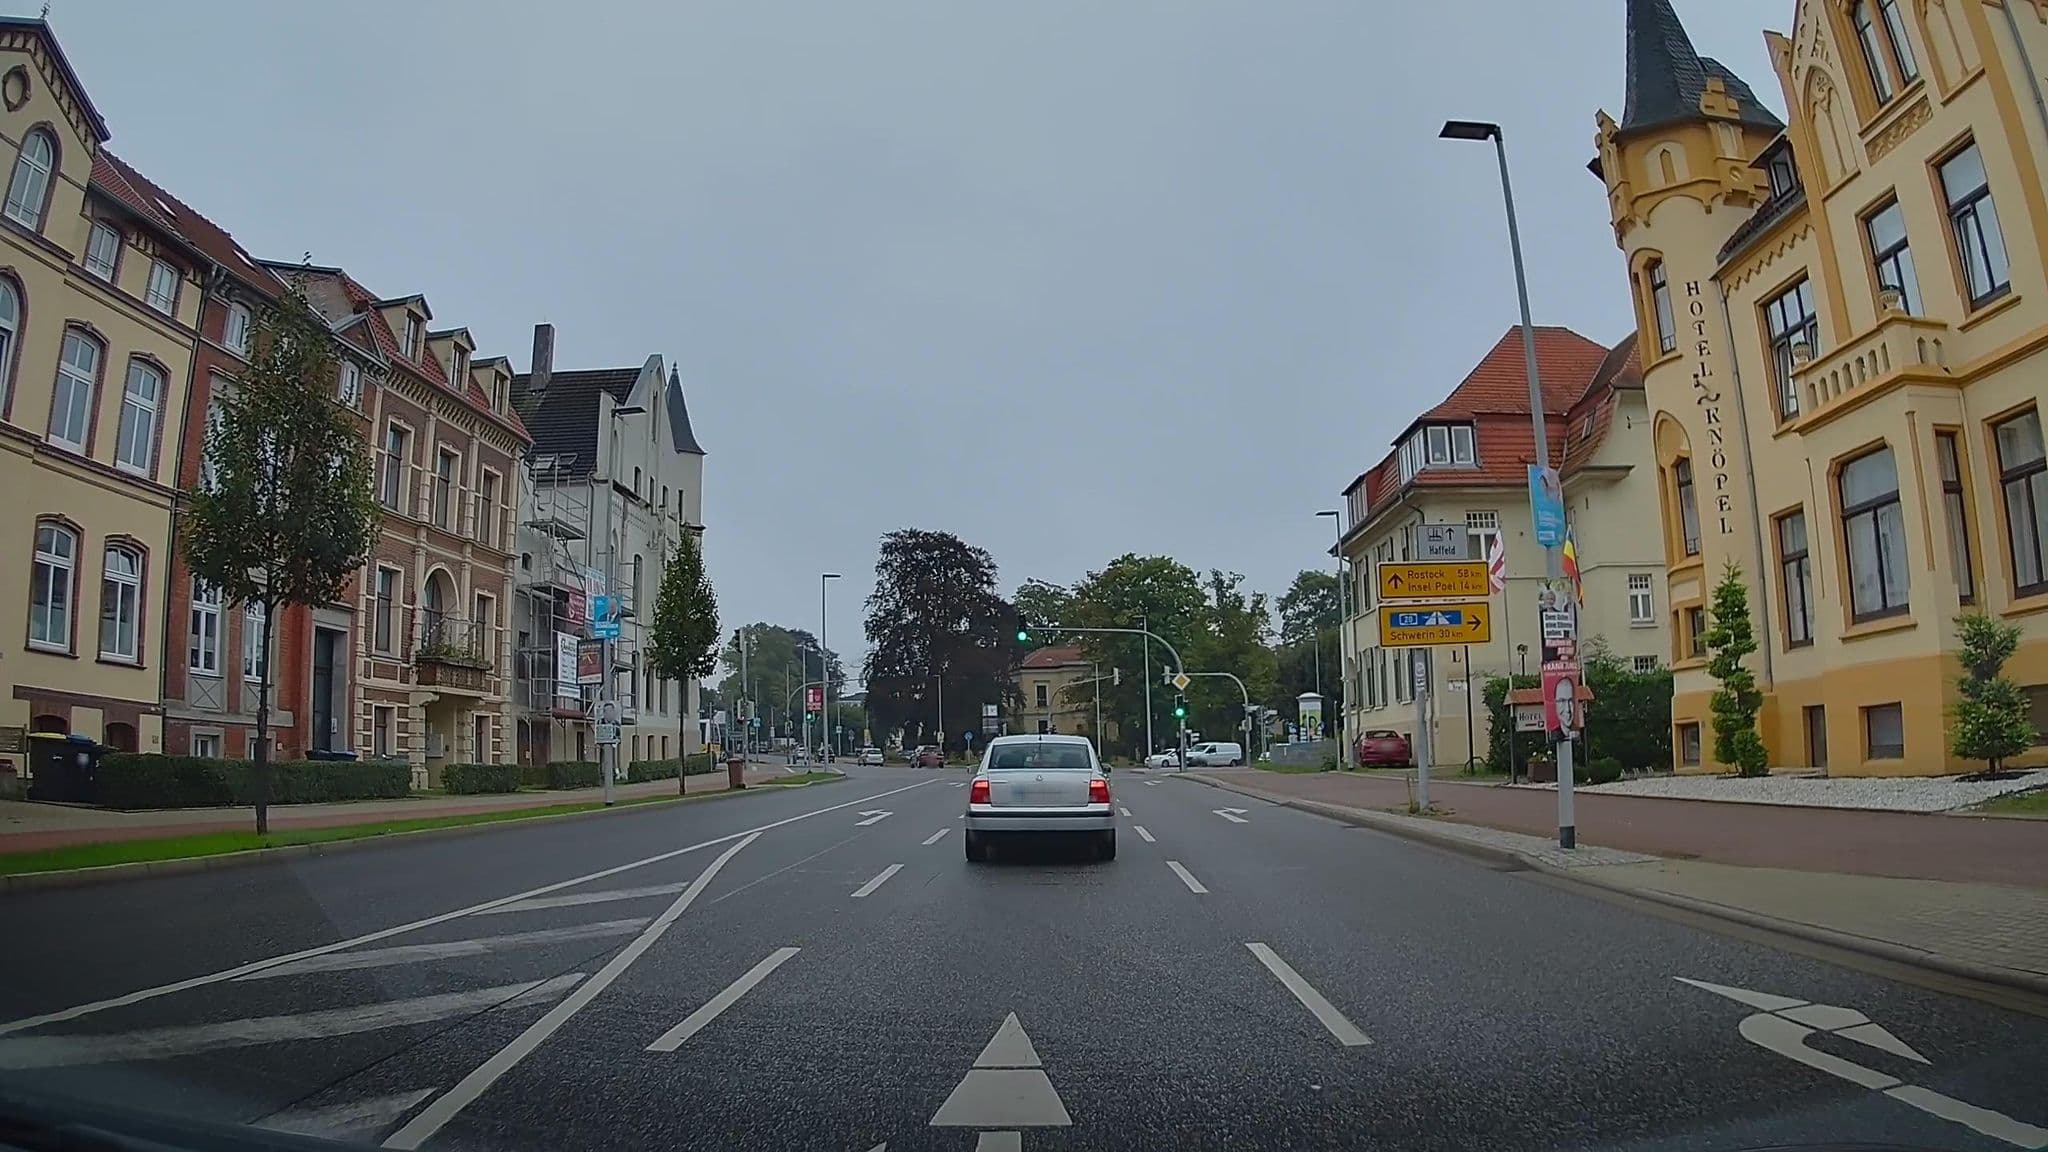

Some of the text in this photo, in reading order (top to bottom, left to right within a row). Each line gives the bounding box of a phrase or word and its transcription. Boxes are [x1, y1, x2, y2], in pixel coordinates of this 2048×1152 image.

[1686, 281, 1733, 535] HOTEL KNÖPEL
[1429, 545, 1456, 555] Haffeld
[1407, 569, 1445, 580] Rostock
[1457, 568, 1470, 578] 58
[1408, 582, 1431, 592] Insel
[1435, 582, 1456, 591] Poel
[1460, 581, 1470, 590] 14
[1403, 615, 1414, 623] 20
[1390, 629, 1463, 641] Schwerin 30 km
